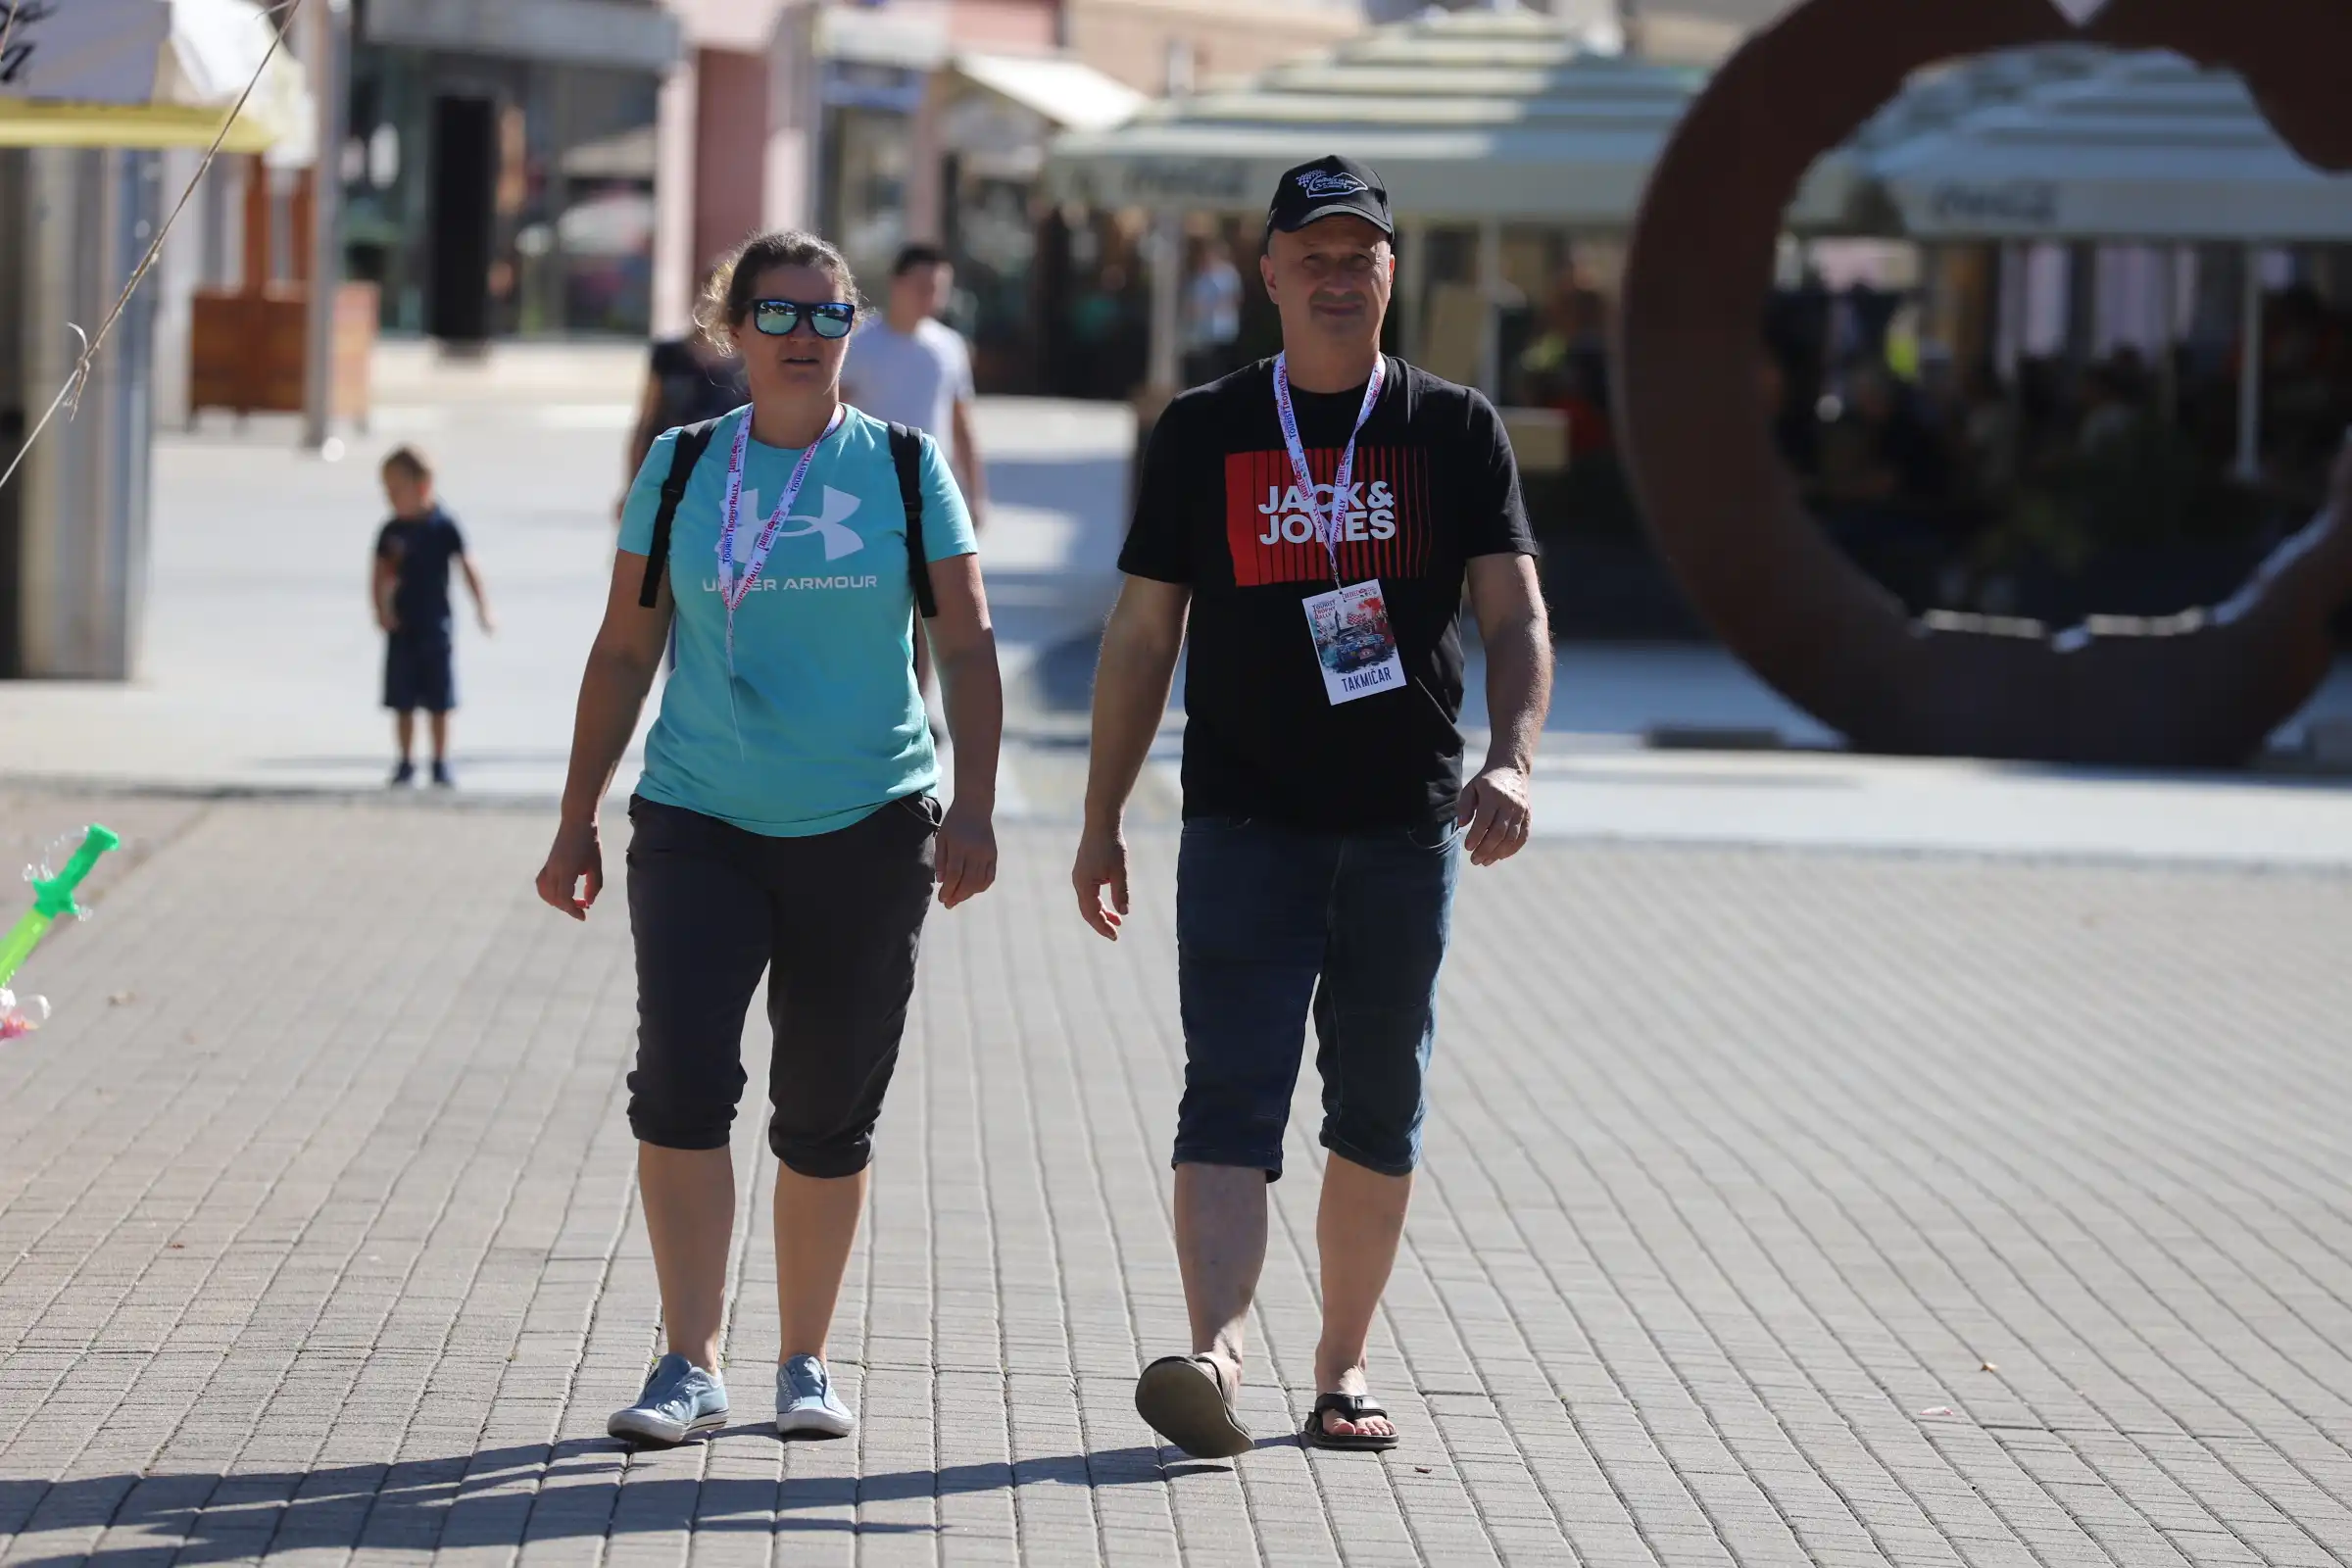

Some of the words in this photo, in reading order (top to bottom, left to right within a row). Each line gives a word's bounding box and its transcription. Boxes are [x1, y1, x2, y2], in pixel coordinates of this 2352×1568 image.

[703, 577, 777, 592] UER
[783, 575, 877, 590] ARMOUR
[1342, 666, 1392, 692] TAKMIČAR
